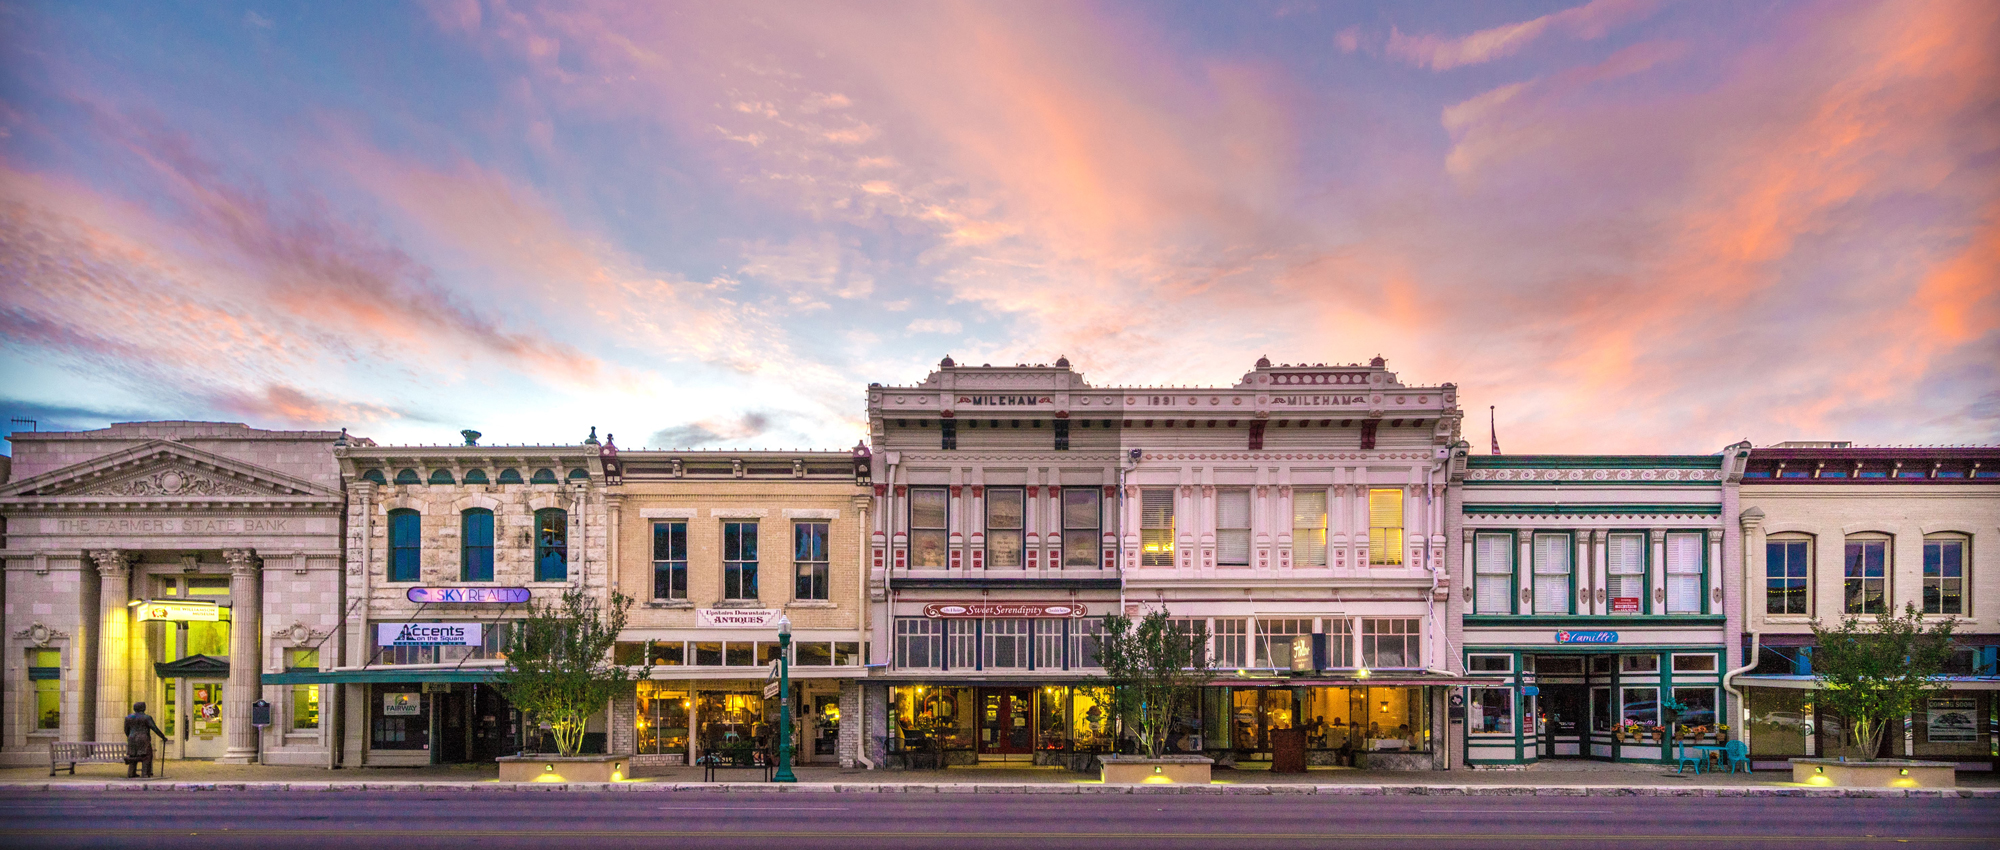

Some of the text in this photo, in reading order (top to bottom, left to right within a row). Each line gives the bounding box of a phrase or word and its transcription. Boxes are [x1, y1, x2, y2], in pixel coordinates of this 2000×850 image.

[973, 395, 1038, 406] MILEHAM
[1286, 395, 1352, 406] MILEHAM
[58, 519, 287, 532] THE FARMERS STATE BANK
[436, 589, 523, 601] SKY REALTY
[966, 605, 1043, 616] Sweet Serendipity
[714, 616, 764, 624] ANTIQUES
[394, 623, 465, 641] Accents
[1570, 632, 1615, 642] Camille's
